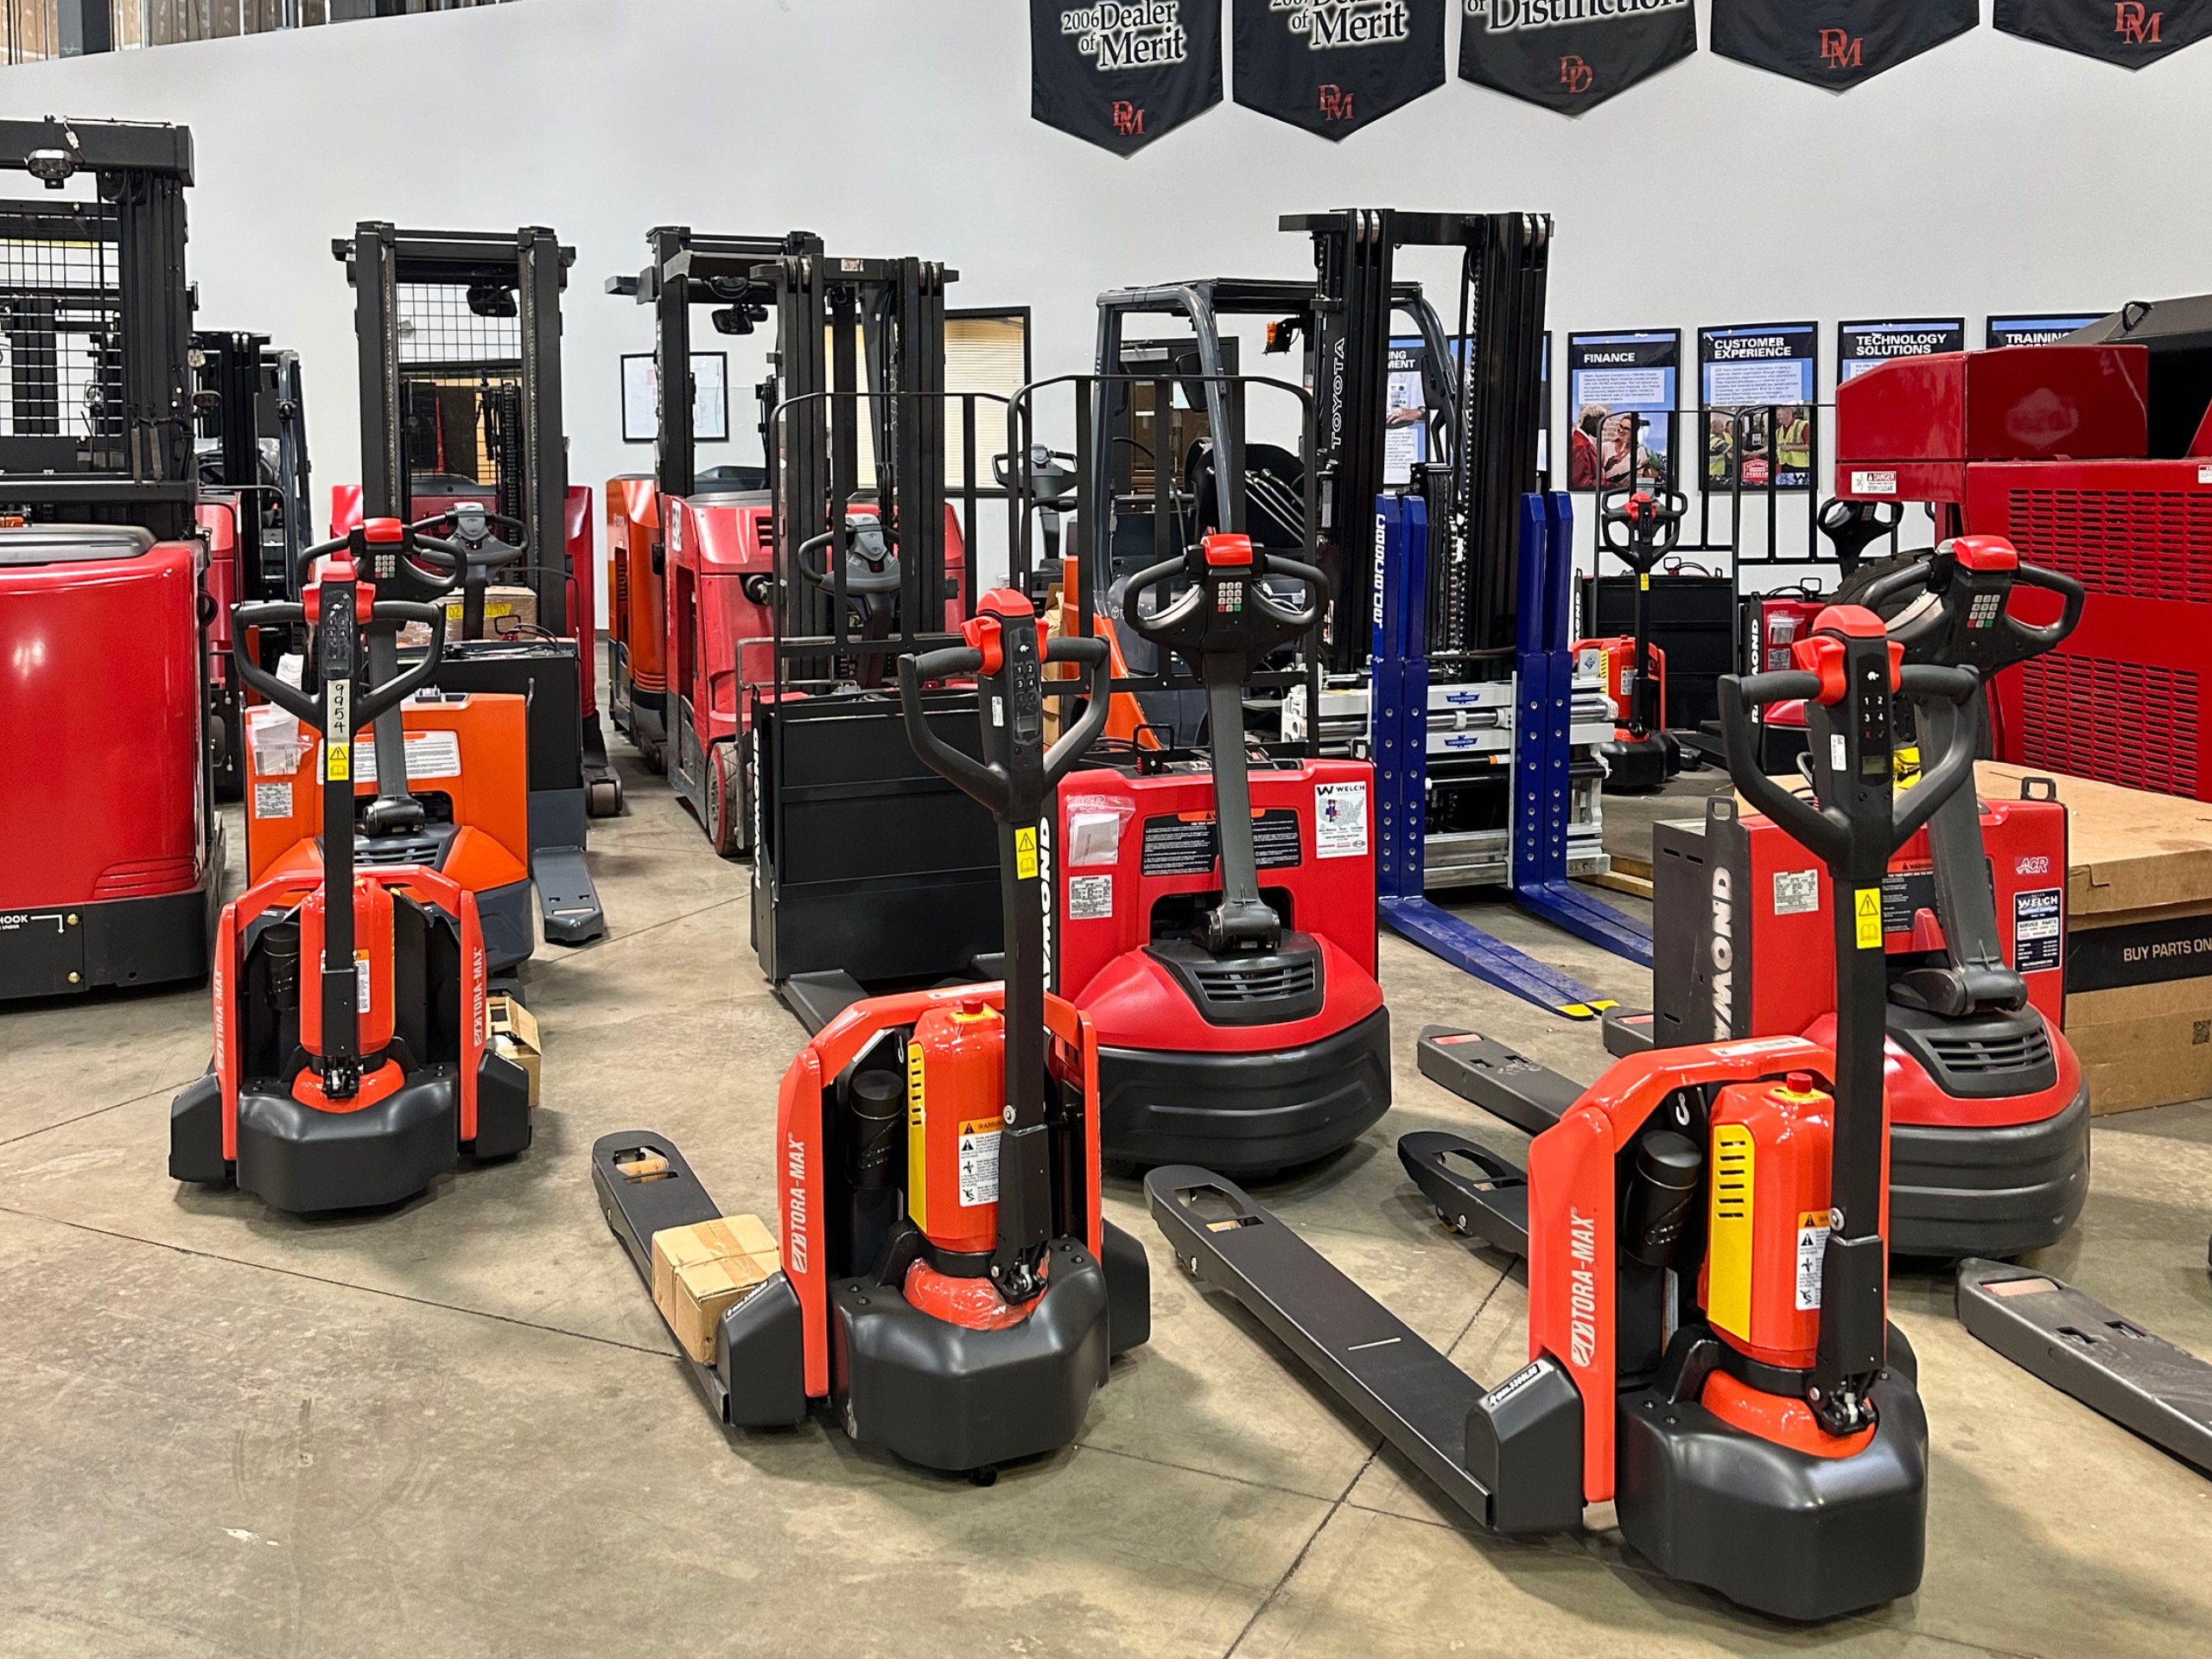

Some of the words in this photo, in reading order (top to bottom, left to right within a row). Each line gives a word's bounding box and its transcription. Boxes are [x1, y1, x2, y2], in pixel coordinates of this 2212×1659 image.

[1063, 10, 1099, 31] 2006
[1099, 0, 1176, 31] Dealer
[1292, 9, 1309, 29] of
[1313, 1, 1406, 46] Merit
[1490, 0, 1685, 29] Distinctio
[1081, 32, 1096, 51] of
[1099, 26, 1184, 67] Merit
[1714, 337, 1784, 350] CUSTOMER
[1714, 346, 1792, 359] EXPERIENCE
[1856, 334, 1947, 346] TECHNOLOGY
[1856, 344, 1931, 356] SOLUTIONS
[1584, 352, 1635, 363] FINANCE
[1331, 337, 1346, 450] TOYOTA
[1040, 817, 1052, 992] YMOND
[2018, 895, 2058, 910] WELCH
[1712, 867, 1732, 1040] YMOND
[2123, 946, 2149, 962] BUY
[2152, 940, 2192, 958] PARTS
[791, 1140, 805, 1235] TORA-MAX
[1570, 1215, 1596, 1321] TORA-MAX
